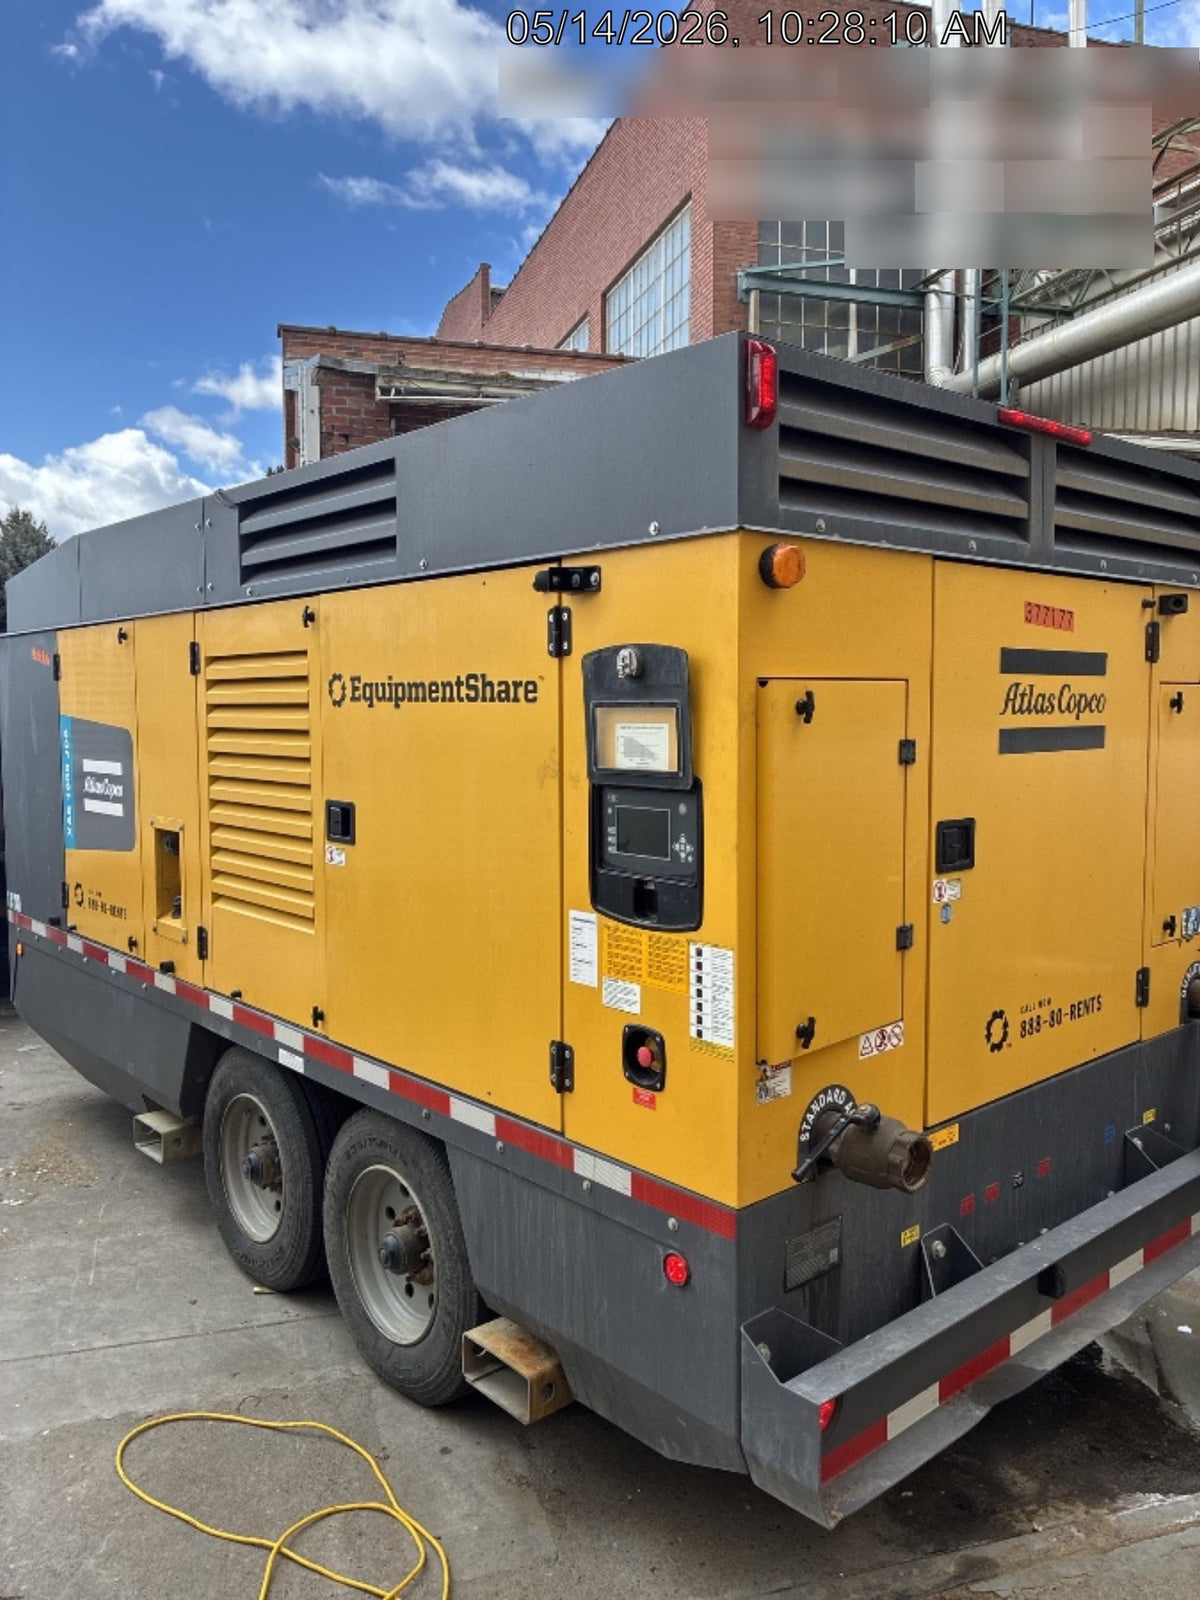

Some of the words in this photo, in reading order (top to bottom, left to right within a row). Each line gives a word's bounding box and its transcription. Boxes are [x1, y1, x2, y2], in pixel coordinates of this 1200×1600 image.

[1025, 601, 1074, 629] 377177
[350, 673, 538, 709] EquipmentShare
[999, 682, 1056, 715] Atlas
[1058, 684, 1106, 720] Copco
[1020, 993, 1102, 1039] 888-80-RENTS
[800, 1088, 847, 1141] STANDARD
